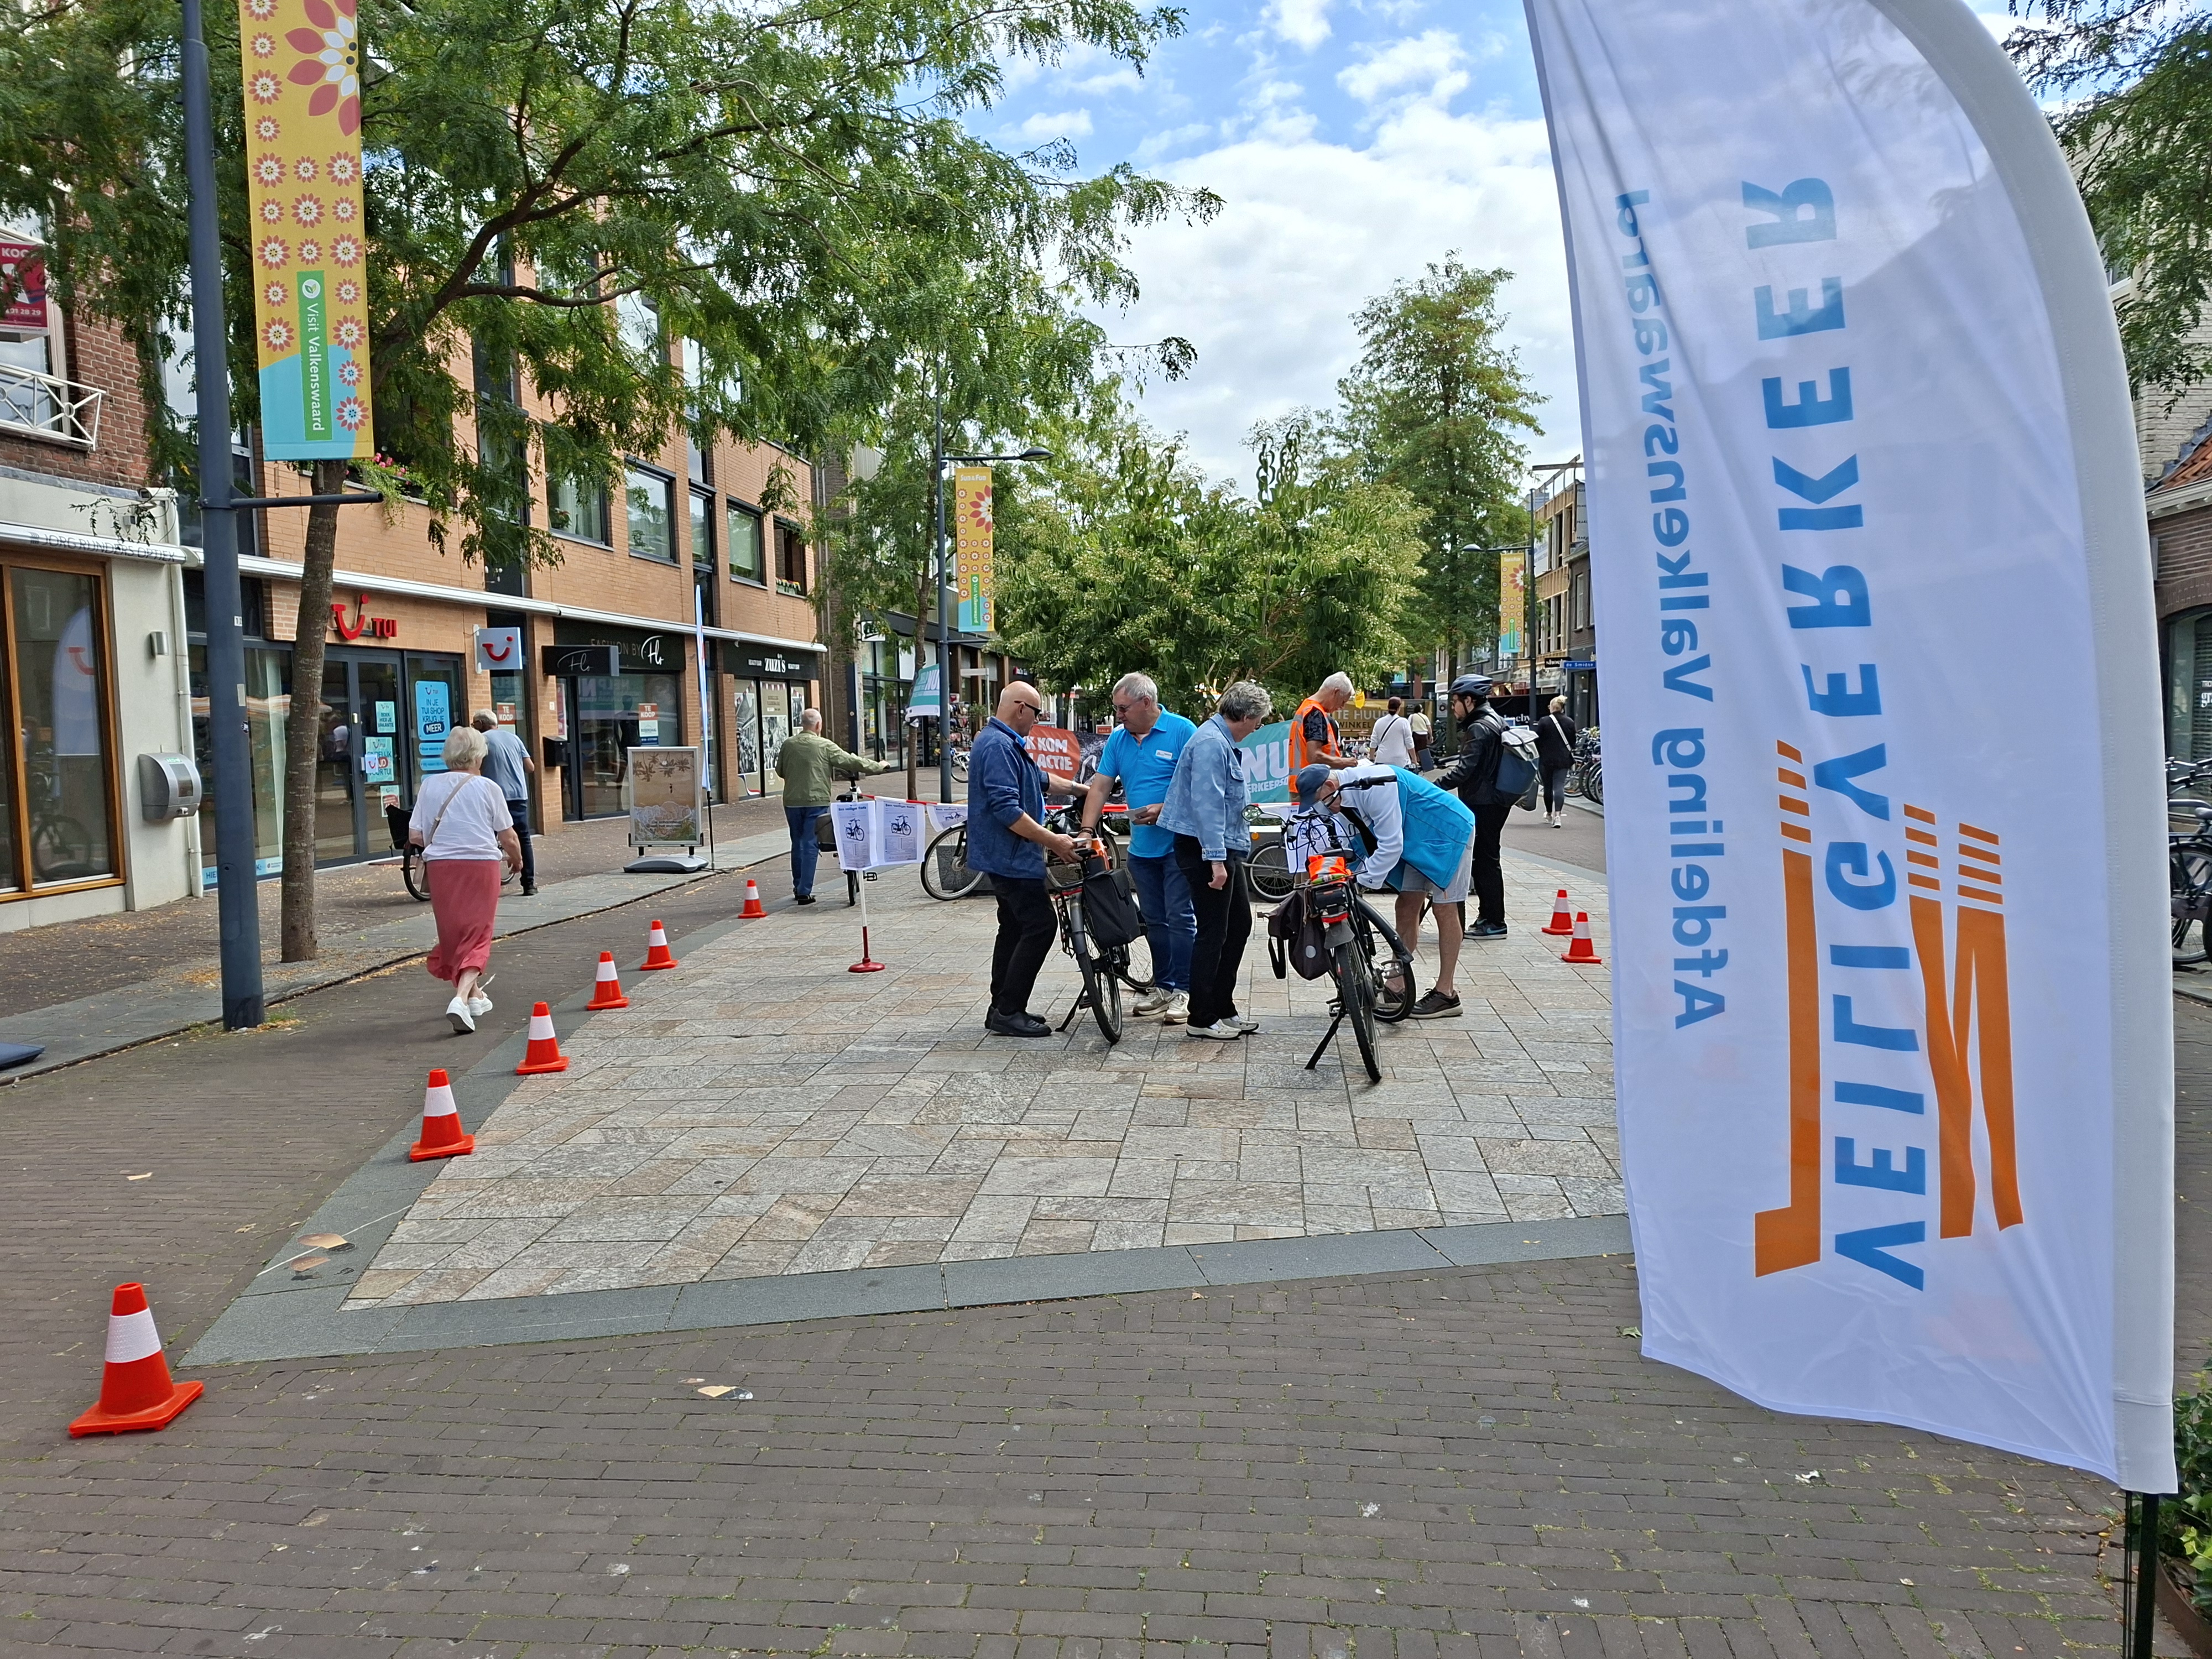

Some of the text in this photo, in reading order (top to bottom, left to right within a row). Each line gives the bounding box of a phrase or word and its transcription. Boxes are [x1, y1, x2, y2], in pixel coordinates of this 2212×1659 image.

[306, 302, 325, 431] Visit Valkenswaard
[137, 547, 175, 562] OPTIEK
[371, 618, 398, 637] TUI
[632, 643, 641, 656] BY
[1337, 709, 1349, 719] TE
[426, 723, 442, 733] MEER
[1037, 737, 1068, 753] KOM
[1037, 753, 1073, 771] ACTIE
[1240, 738, 1290, 783] NU
